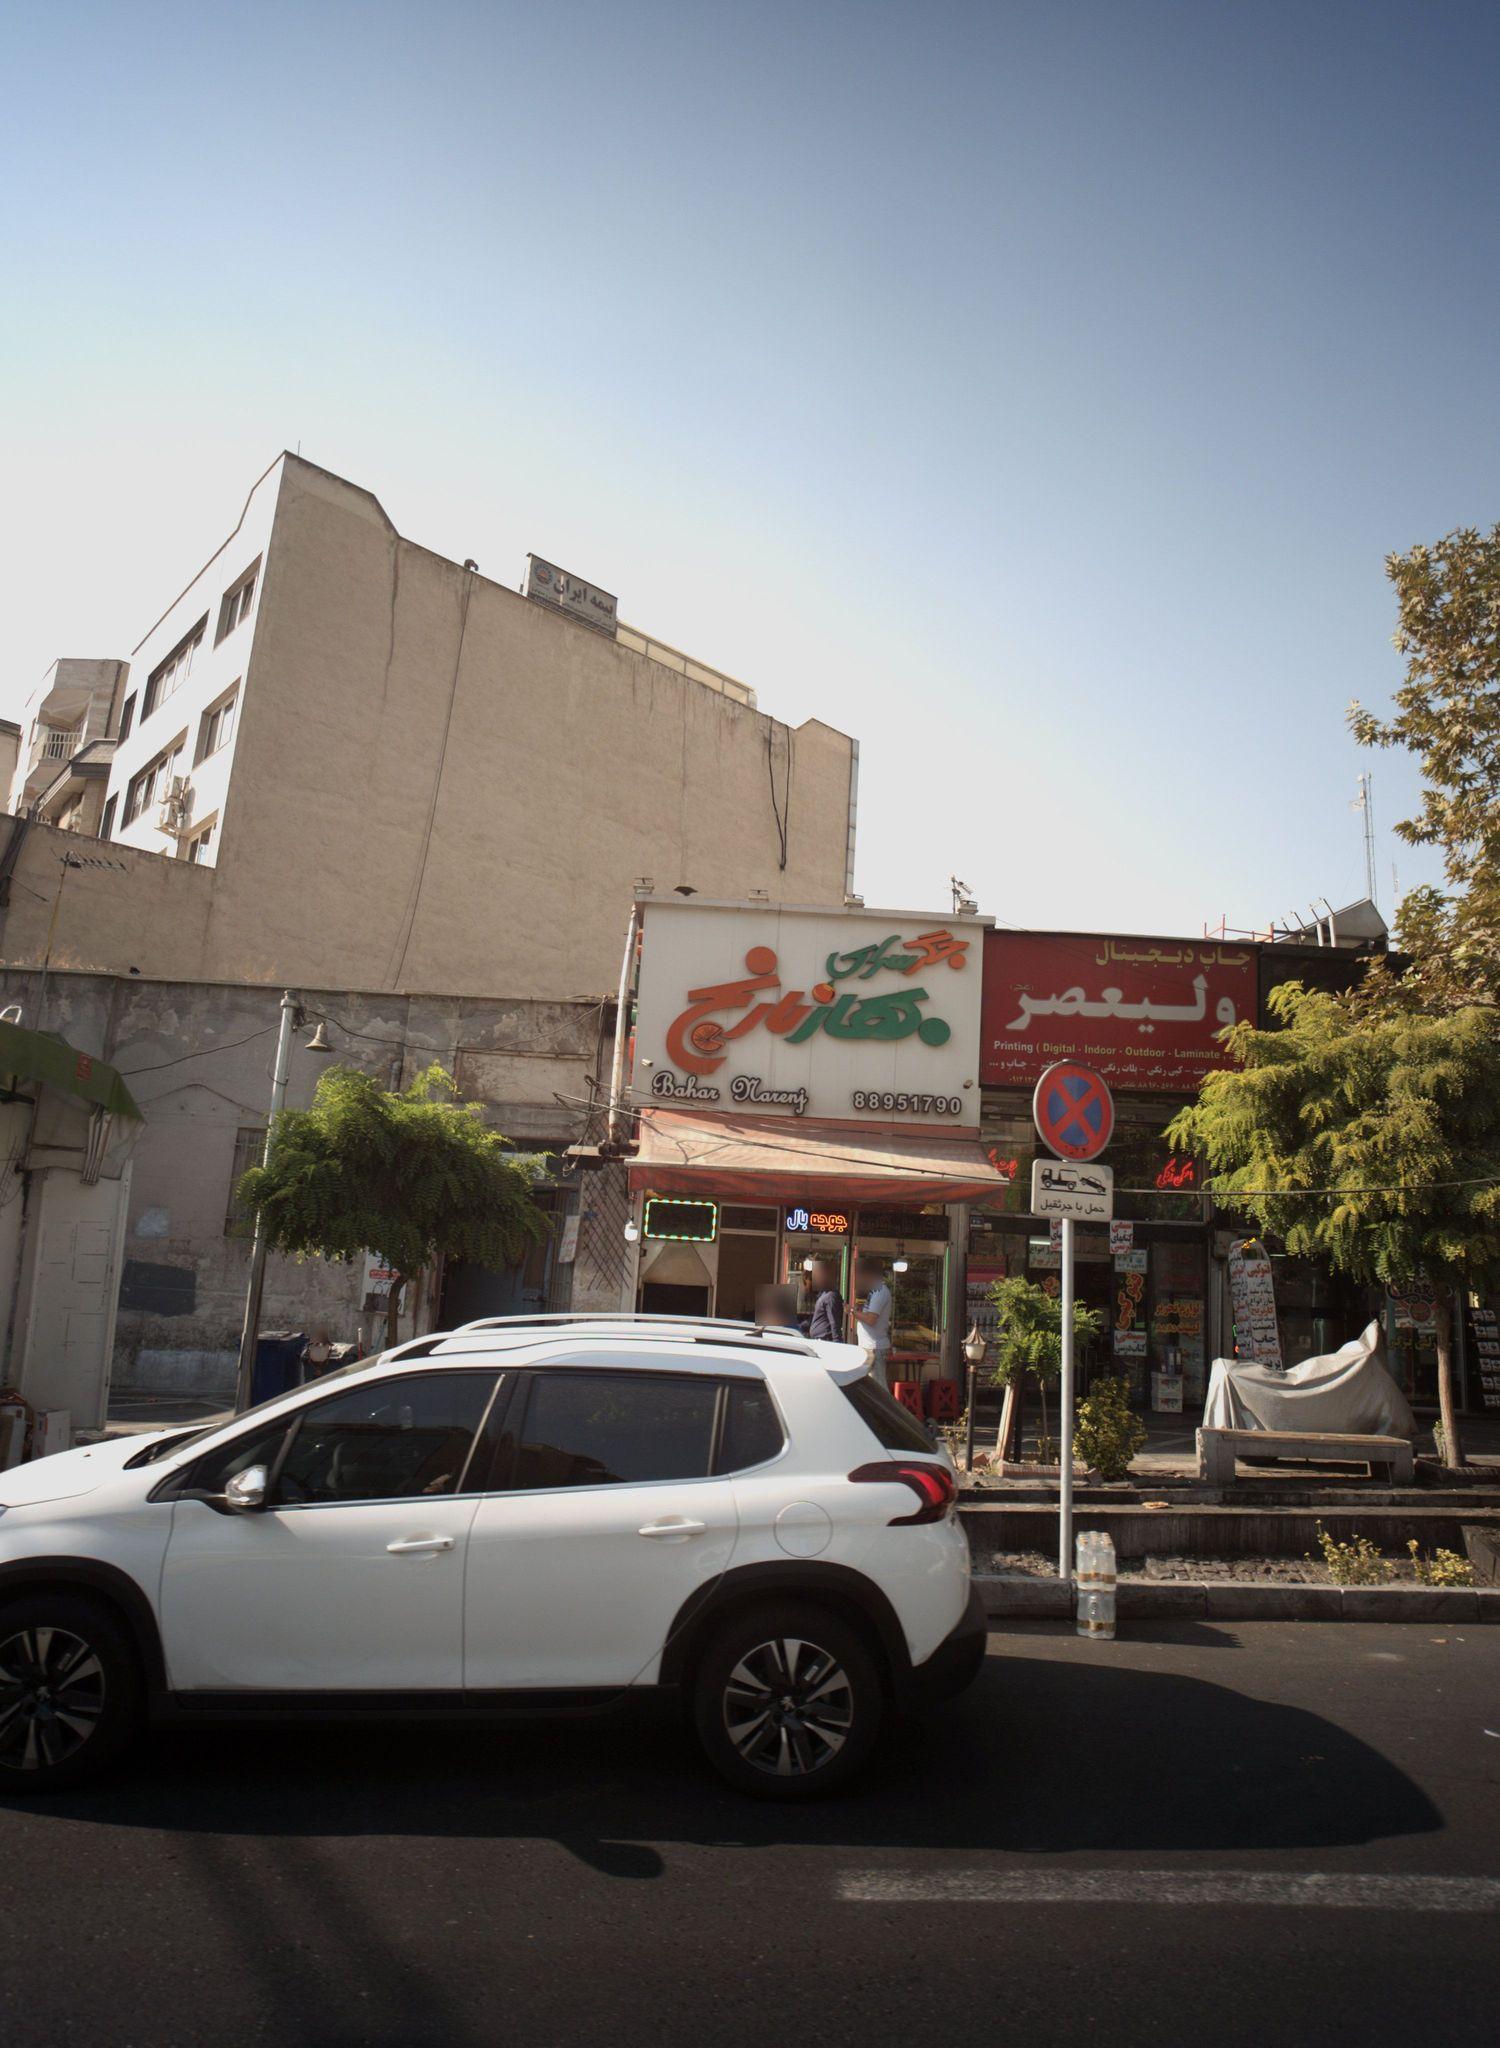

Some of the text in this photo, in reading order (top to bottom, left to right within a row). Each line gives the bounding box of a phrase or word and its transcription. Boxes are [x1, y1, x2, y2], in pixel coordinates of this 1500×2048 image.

[553, 578, 587, 604] ایران
[591, 596, 614, 619] بیمه
[1095, 939, 1252, 973] چاپ دیجیتال
[666, 945, 952, 1075] بهار نارنج
[1005, 972, 1238, 1040] ولیعصر
[993, 1040, 1220, 1059] Printing Digital Indoor Outdoor Laminate
[1007, 1057, 1028, 1069] چاپ
[1100, 1062, 1121, 1074] رنگی
[1147, 1065, 1167, 1077] رنگی
[651, 1070, 963, 1116] Bahar Narenj 88951790
[1040, 1198, 1105, 1214] حمل با جرثقیل
[786, 1208, 809, 1231] بال
[809, 1213, 848, 1233] جوجه
[1254, 1334, 1277, 1346] چاپ
